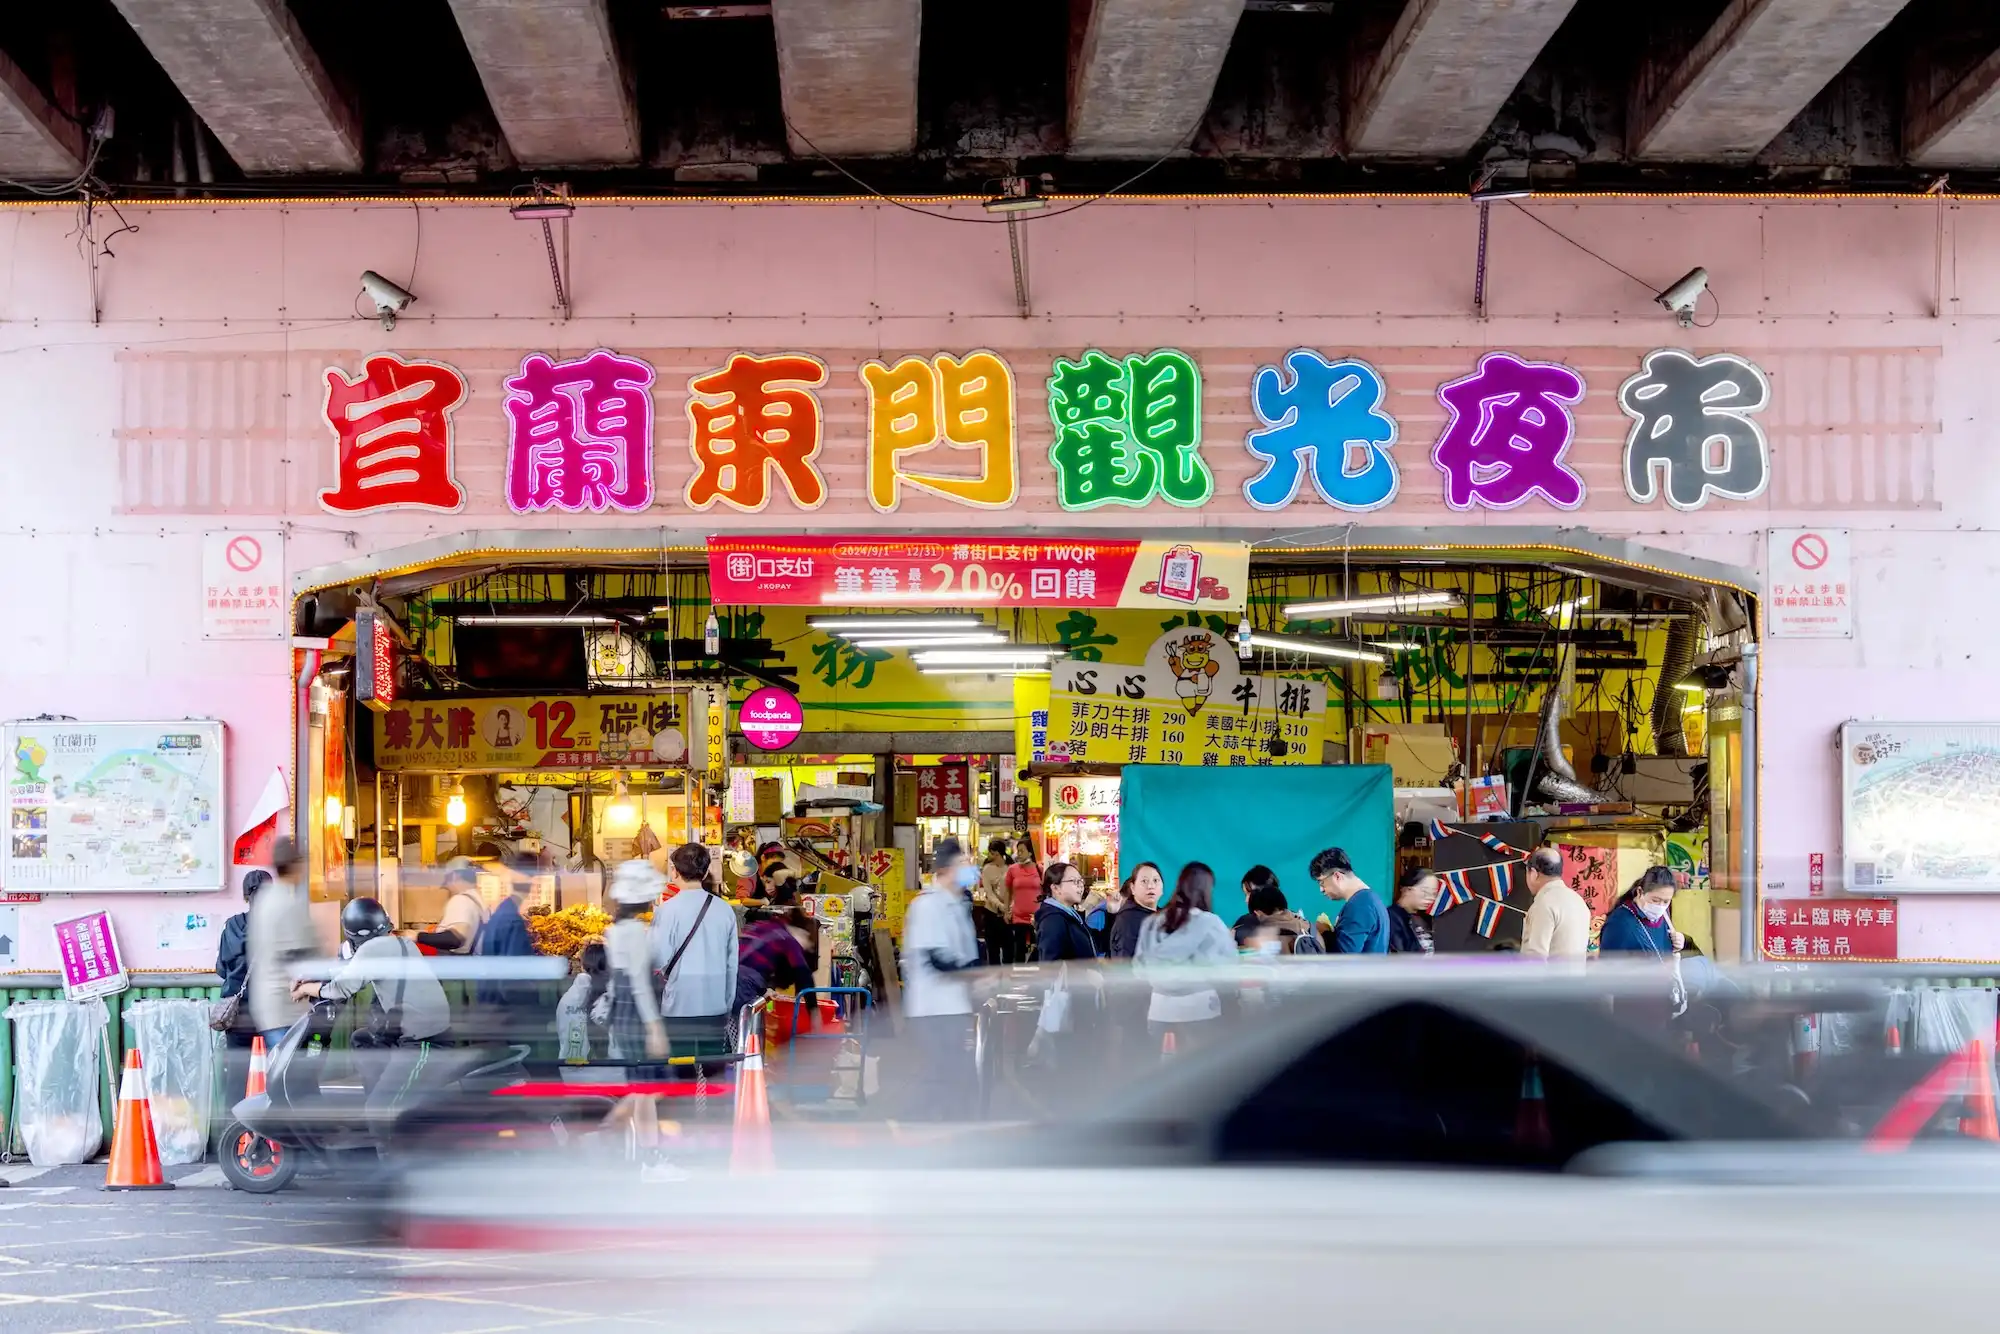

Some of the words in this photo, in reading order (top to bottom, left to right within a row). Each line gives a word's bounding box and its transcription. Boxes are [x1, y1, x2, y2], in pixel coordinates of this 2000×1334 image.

[318, 348, 1772, 514] 宜蘭東門觀光夜市
[952, 544, 1038, 561] 掃街口支付
[1044, 546, 1096, 561] TWQR
[729, 555, 815, 579] 街口支付
[834, 567, 899, 597] 筆筆
[931, 563, 1023, 600] 20%
[1031, 568, 1096, 600] 回饋
[1067, 669, 1148, 699] 心心
[1232, 677, 1311, 720] 牛排
[750, 710, 792, 721] foodpanda
[1072, 701, 1151, 726] 菲力牛排
[1162, 712, 1186, 726] 290
[1069, 720, 1149, 743] 沙朗牛排
[1161, 730, 1184, 744] 160
[1206, 714, 1277, 735] 美國牛小排
[1284, 723, 1308, 737] 310
[1204, 733, 1272, 752] 大蒜牛排
[1160, 749, 1183, 763] 130
[1768, 907, 1894, 927] 禁止臨時停車
[1768, 935, 1851, 956] 違者拖吊
